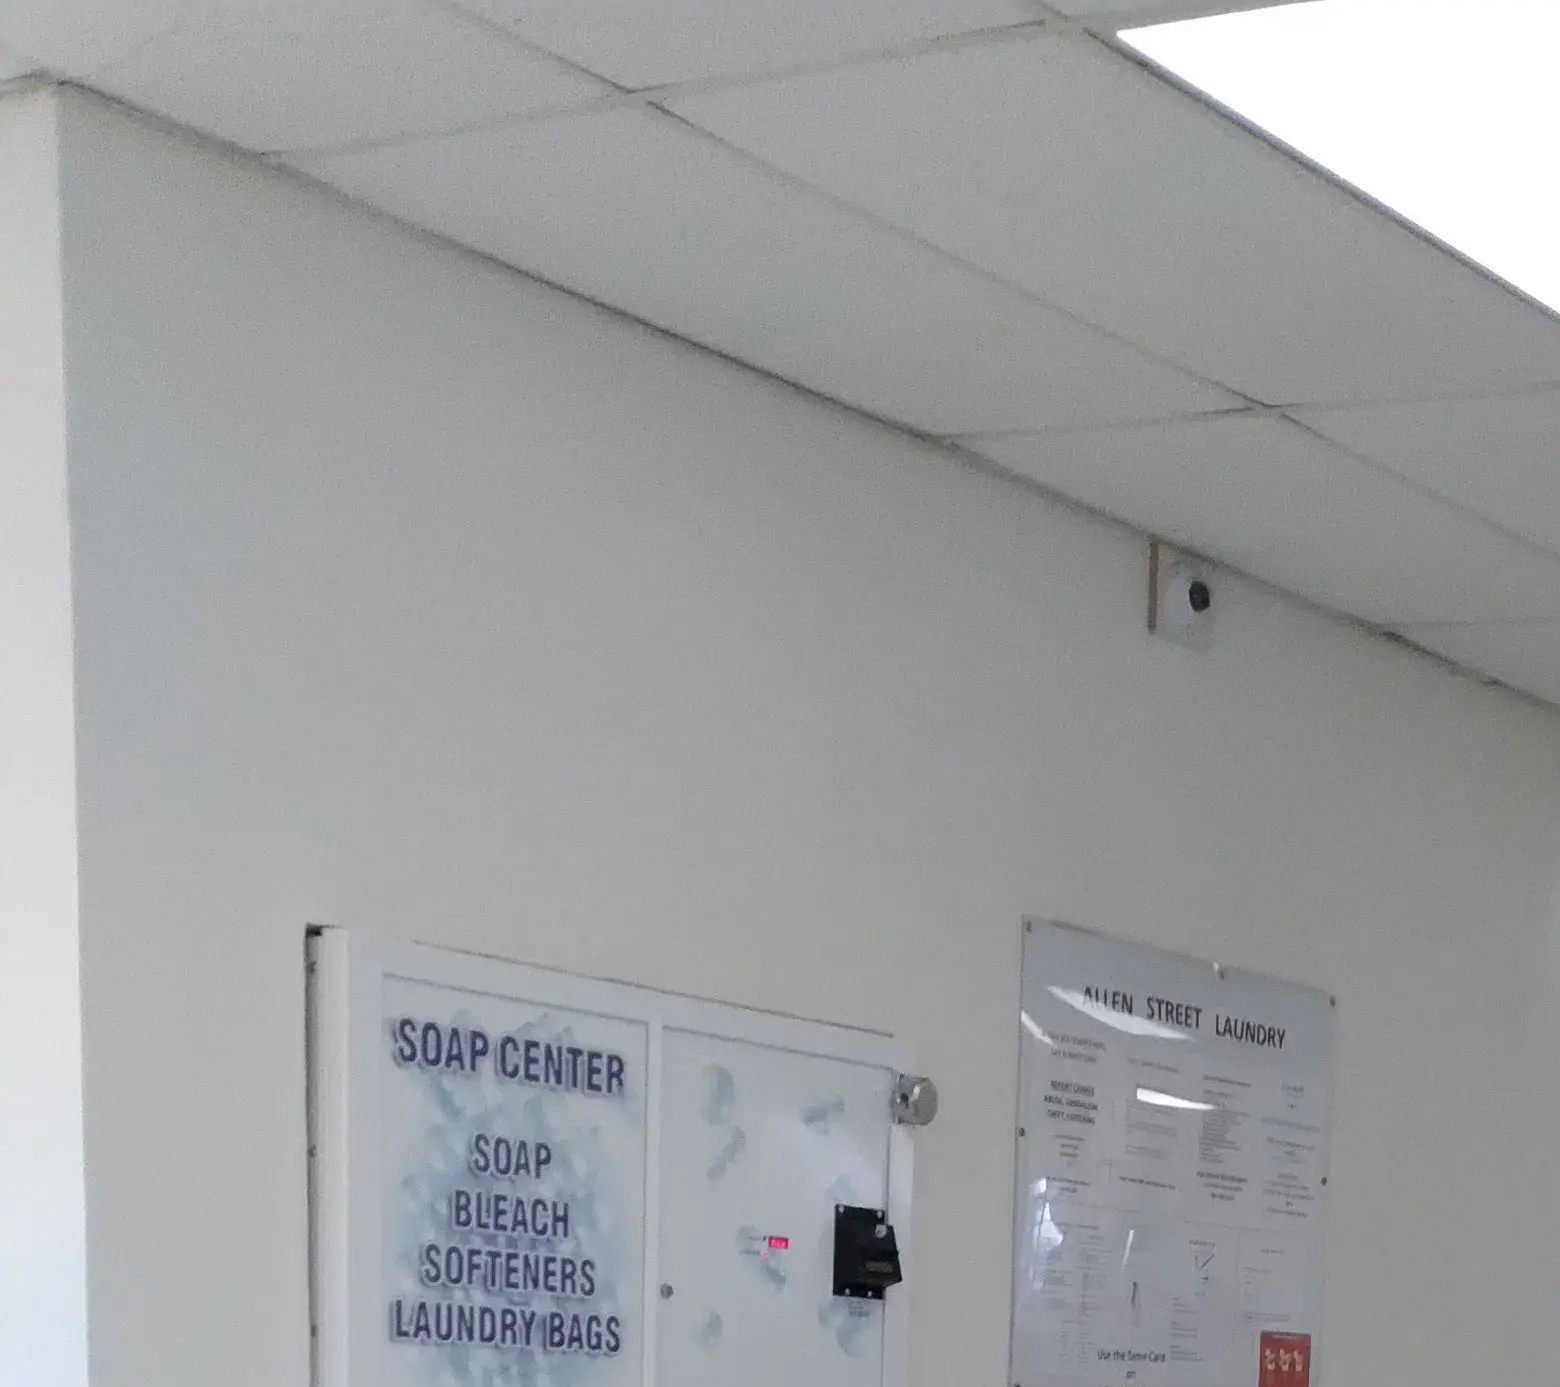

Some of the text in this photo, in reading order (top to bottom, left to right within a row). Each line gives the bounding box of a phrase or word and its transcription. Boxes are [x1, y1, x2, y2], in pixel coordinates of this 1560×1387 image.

[1146, 996, 1203, 1030] STREET
[1215, 1014, 1287, 1049] LAUNDRY
[396, 1018, 625, 1095] SOAP CENTER
[473, 1134, 552, 1179] SOAP
[453, 1190, 570, 1239] BLEACH
[423, 1244, 597, 1298] SOFTENERS
[394, 1300, 622, 1355] LAUNDRY BAGS
